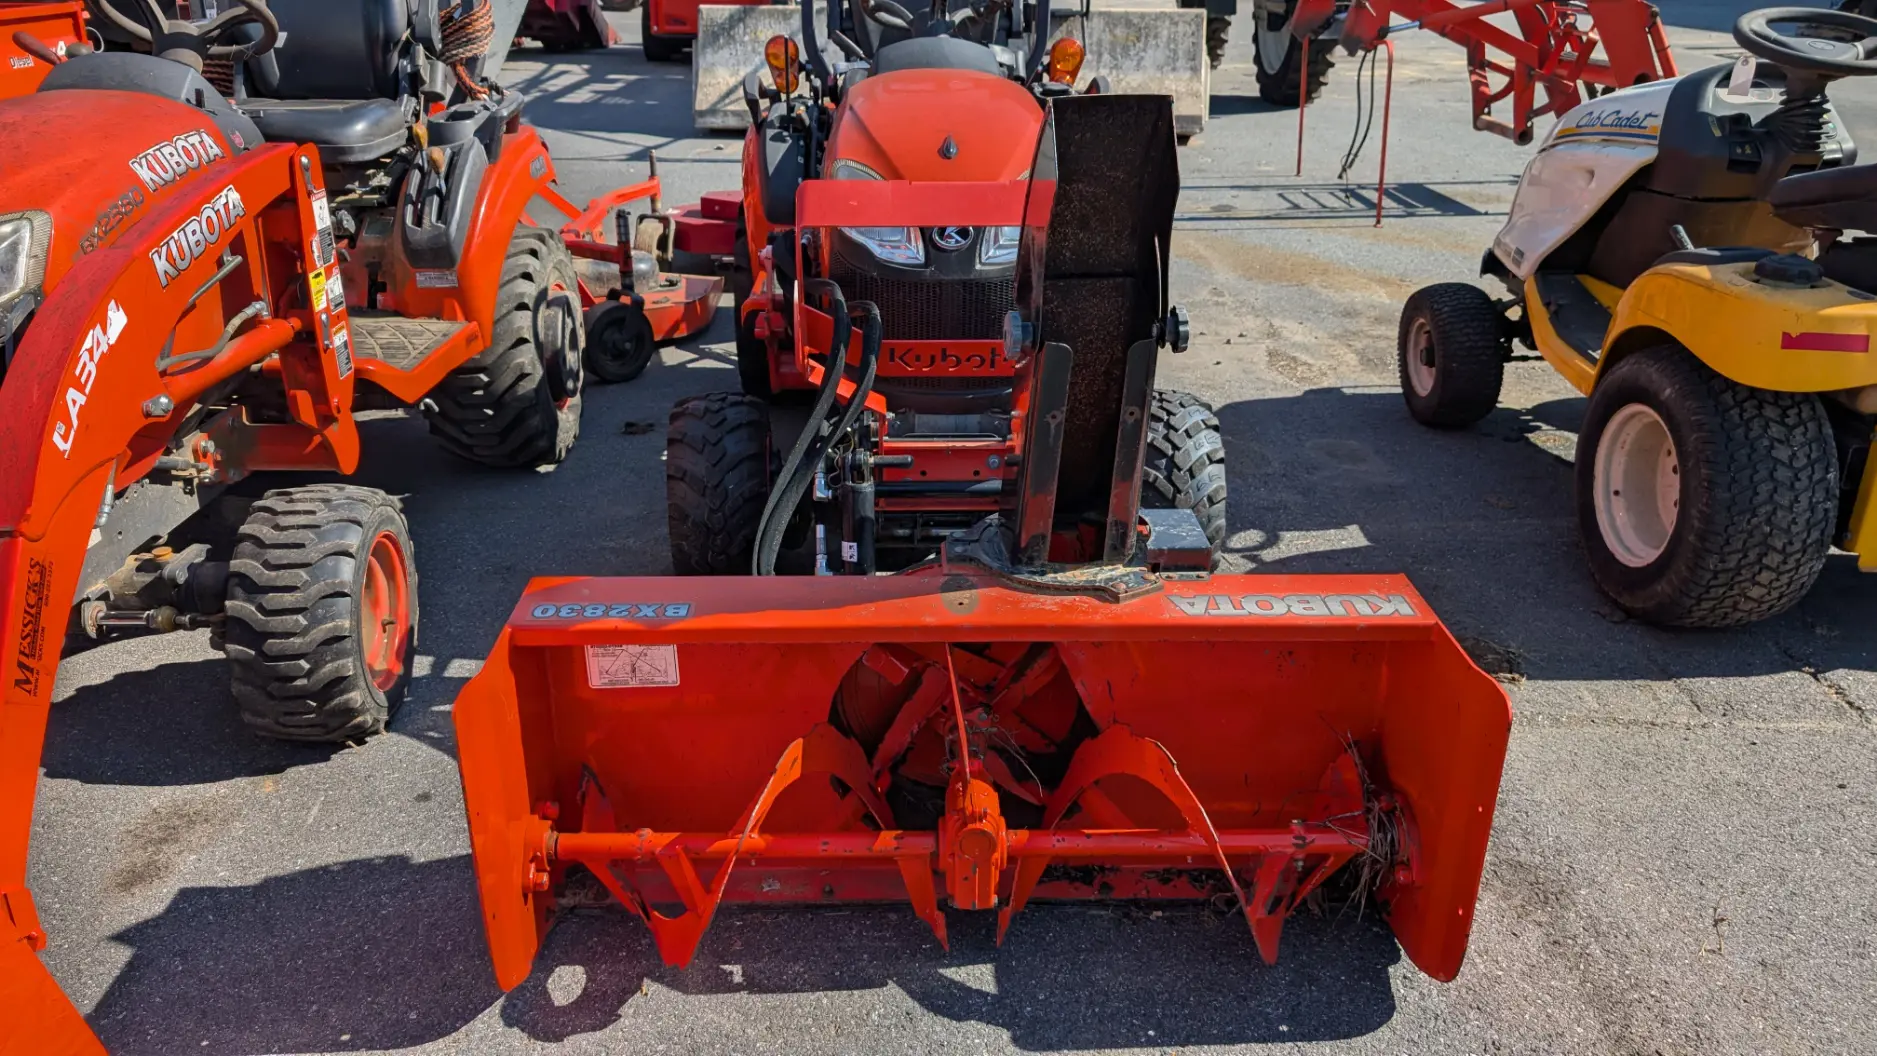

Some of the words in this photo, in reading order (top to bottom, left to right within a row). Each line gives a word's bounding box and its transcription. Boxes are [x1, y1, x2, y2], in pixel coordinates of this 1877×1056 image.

[1576, 109, 1603, 129] Cub
[1601, 110, 1659, 129] Cadet
[129, 129, 225, 193] KUBOTA
[149, 185, 246, 289] KUBOTA
[888, 347, 1009, 372] Kubot
[532, 603, 691, 619] BX2830
[1164, 594, 1417, 617] KUBOTA
